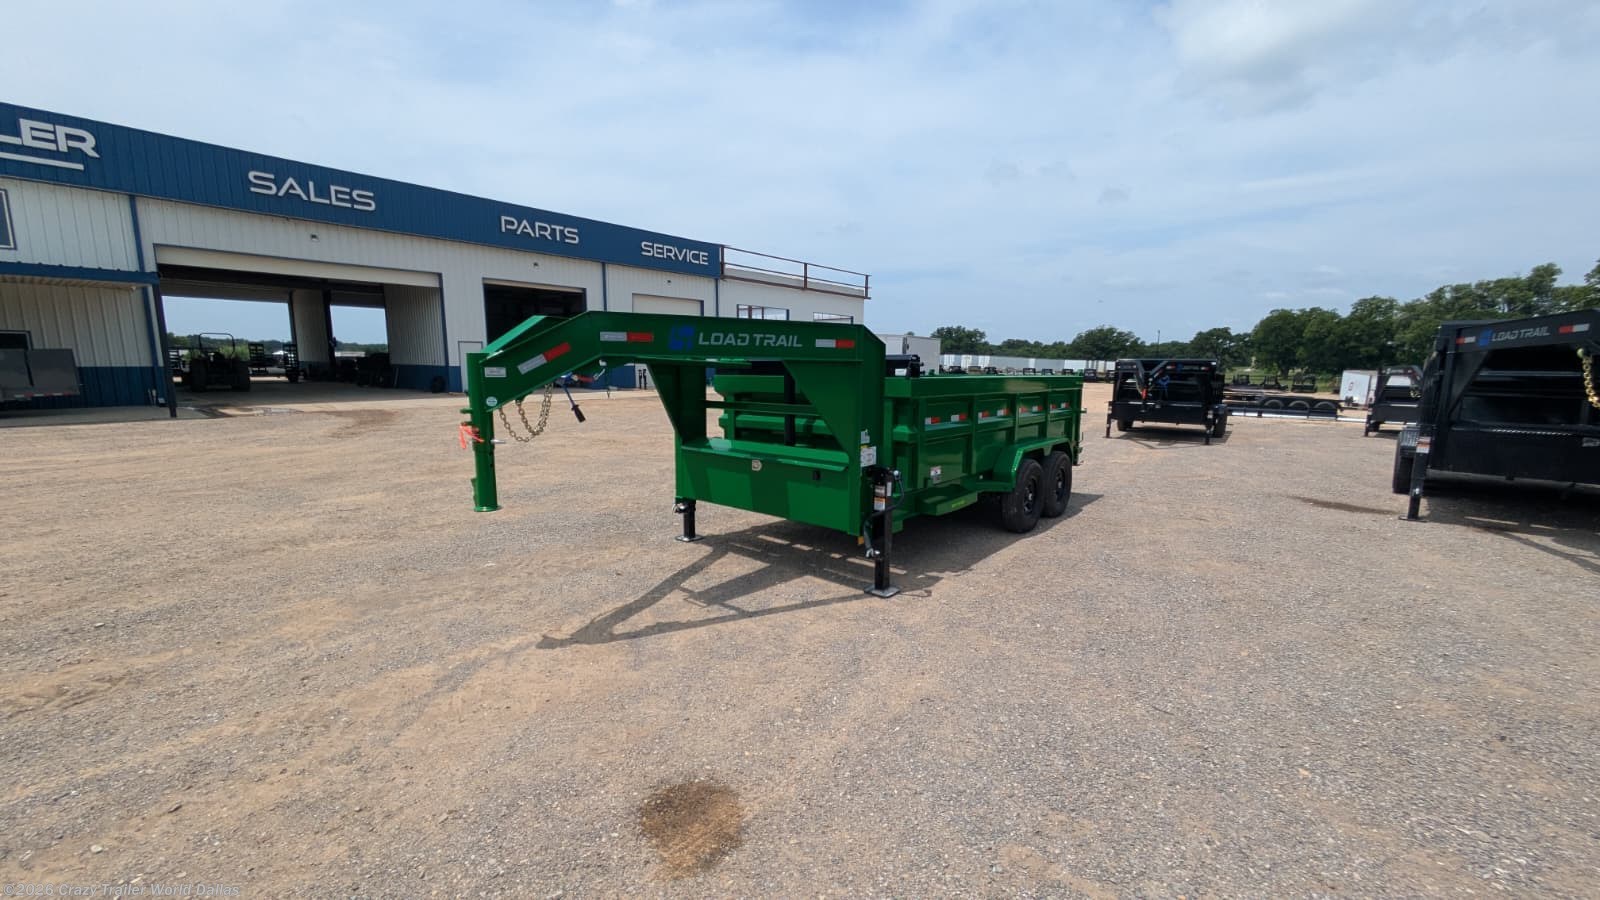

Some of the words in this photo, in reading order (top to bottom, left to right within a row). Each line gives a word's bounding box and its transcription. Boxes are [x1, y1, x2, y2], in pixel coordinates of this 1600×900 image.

[247, 170, 377, 212] SALES
[500, 215, 579, 244] PARTS
[640, 241, 709, 265] SERVICE
[698, 332, 750, 346] LOAD
[753, 333, 803, 347] TRAIL
[1492, 330, 1519, 342] LOAD
[1520, 326, 1550, 339] TRAIL
